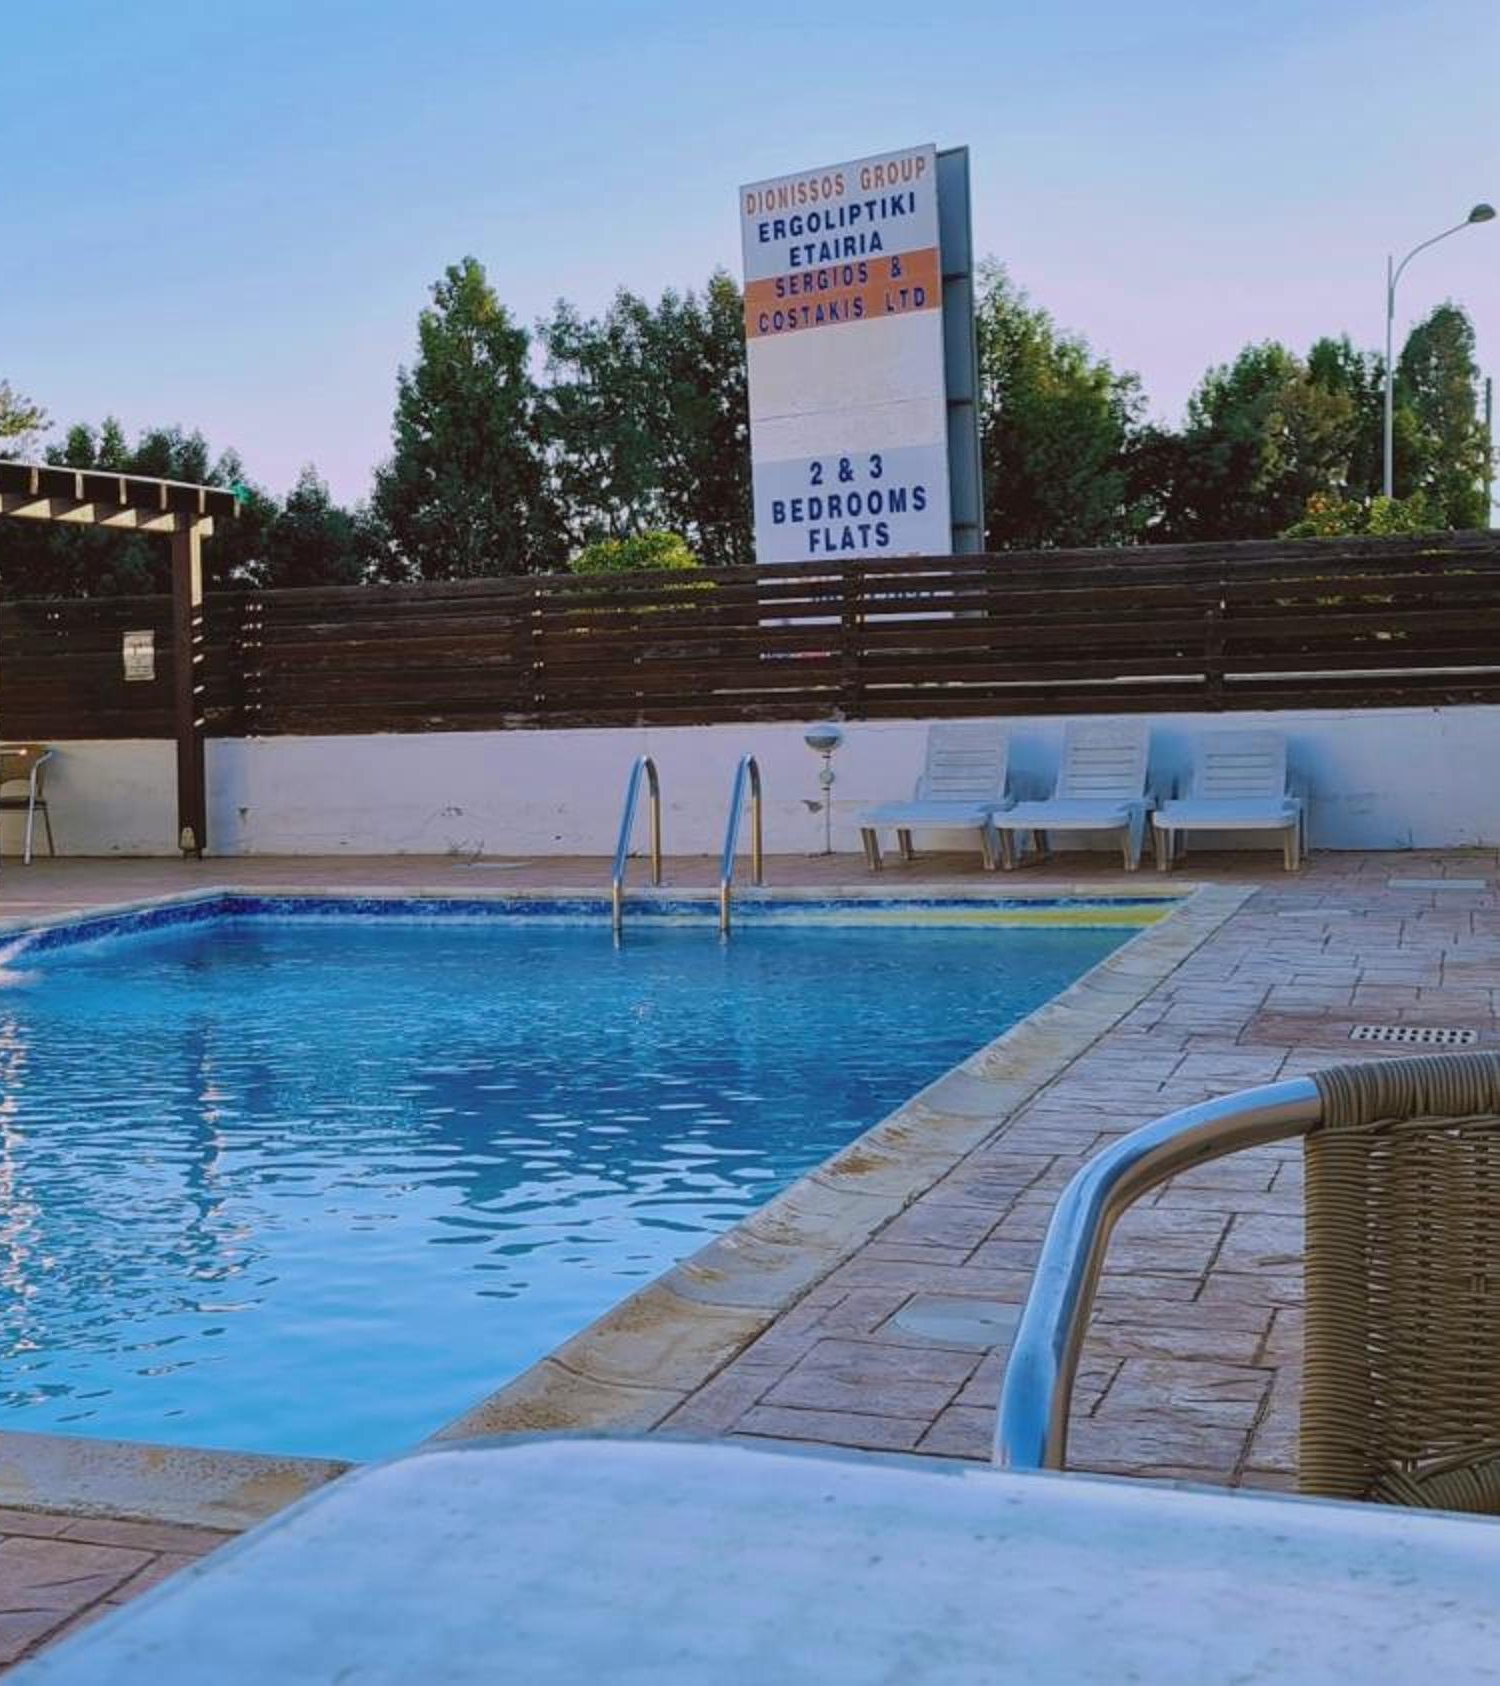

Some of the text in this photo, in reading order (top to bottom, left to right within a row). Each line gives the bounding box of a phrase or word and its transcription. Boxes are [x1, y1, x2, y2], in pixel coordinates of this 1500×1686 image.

[746, 156, 926, 215] DIONISSOS GROUP
[758, 191, 916, 243] ERGOLIPTIKI
[789, 231, 883, 267] ETAIRIA
[774, 256, 902, 298] SERGIOS &
[759, 287, 926, 333] COSTAKIS LTD
[810, 454, 883, 485] 2 & 3
[772, 486, 927, 524] BEDROOMS
[809, 522, 890, 552] FLATS
